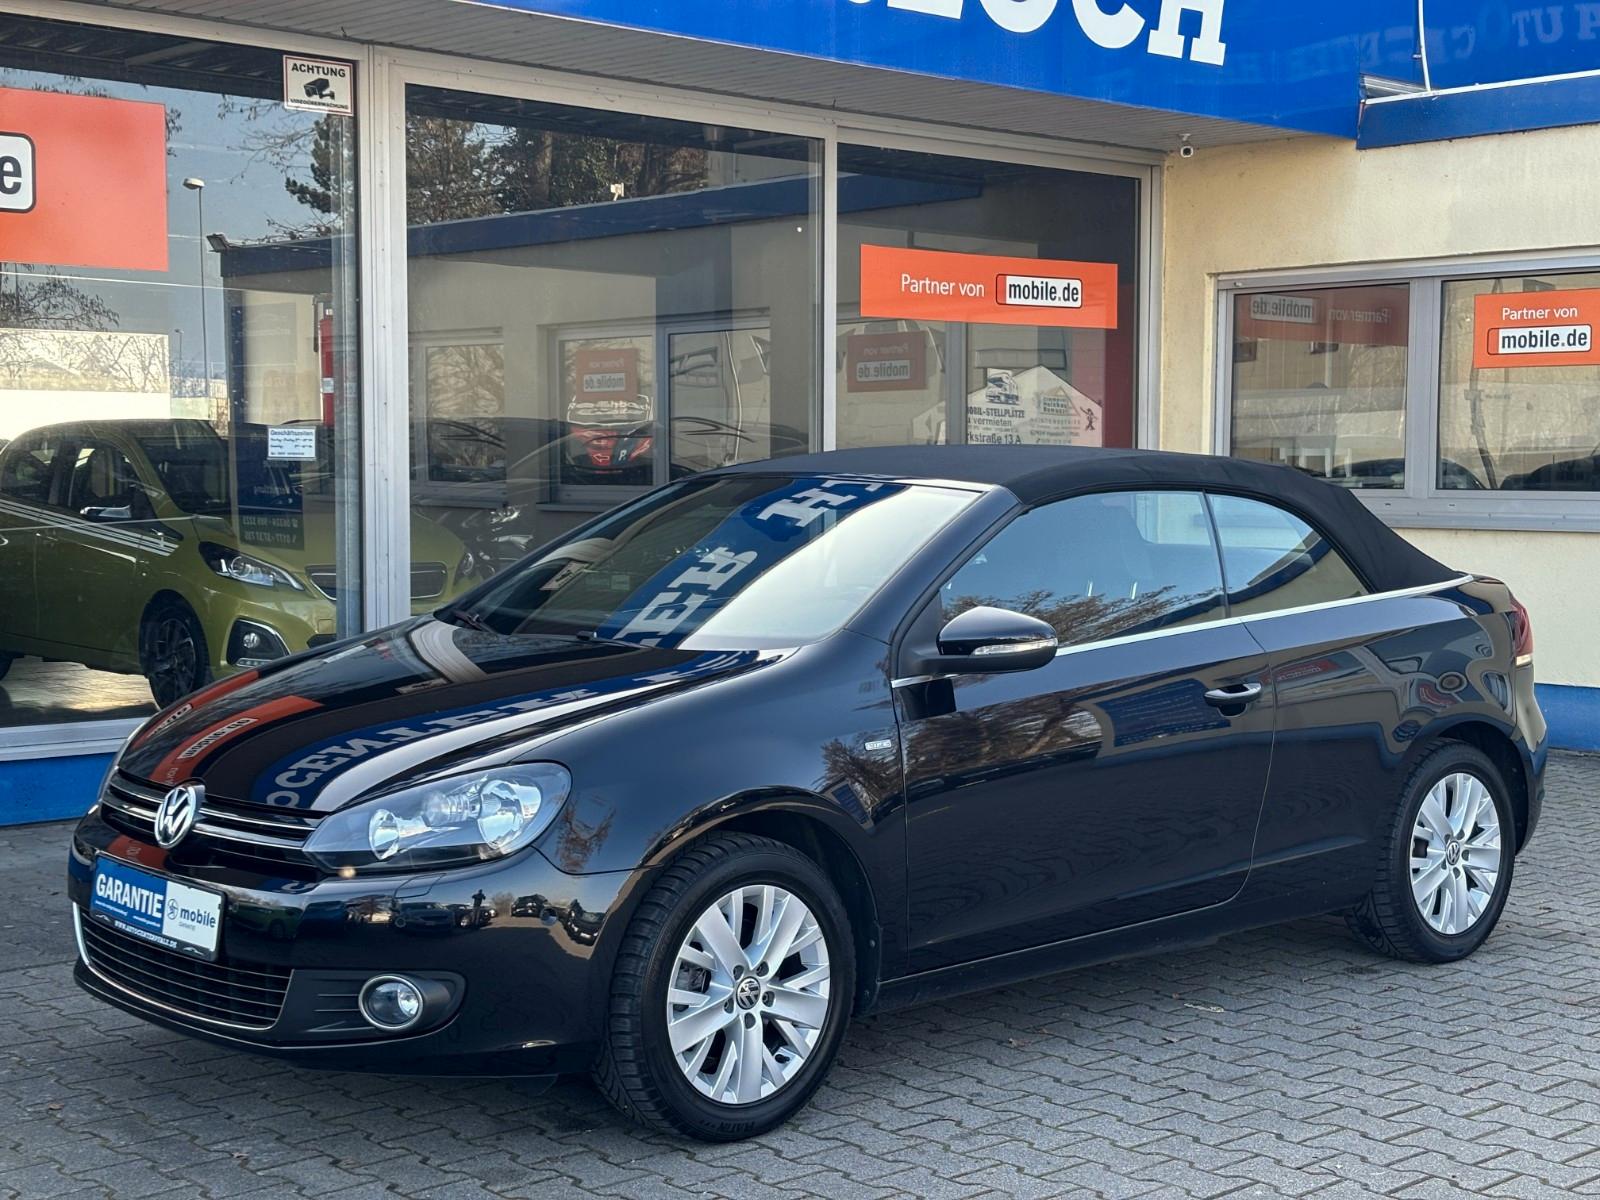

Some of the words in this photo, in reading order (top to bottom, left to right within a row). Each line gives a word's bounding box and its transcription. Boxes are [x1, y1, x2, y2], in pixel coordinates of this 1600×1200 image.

[291, 62, 346, 78] ACHTUNG
[901, 273, 955, 296] Partner
[959, 283, 985, 297] von
[1008, 281, 1079, 302] mobile.de
[1502, 307, 1551, 320] Partner
[1553, 307, 1578, 318] von
[1501, 329, 1588, 349] mobile.de
[973, 417, 1012, 427] vermieten
[96, 873, 164, 918] GARANTIE
[180, 905, 216, 928] mobile
